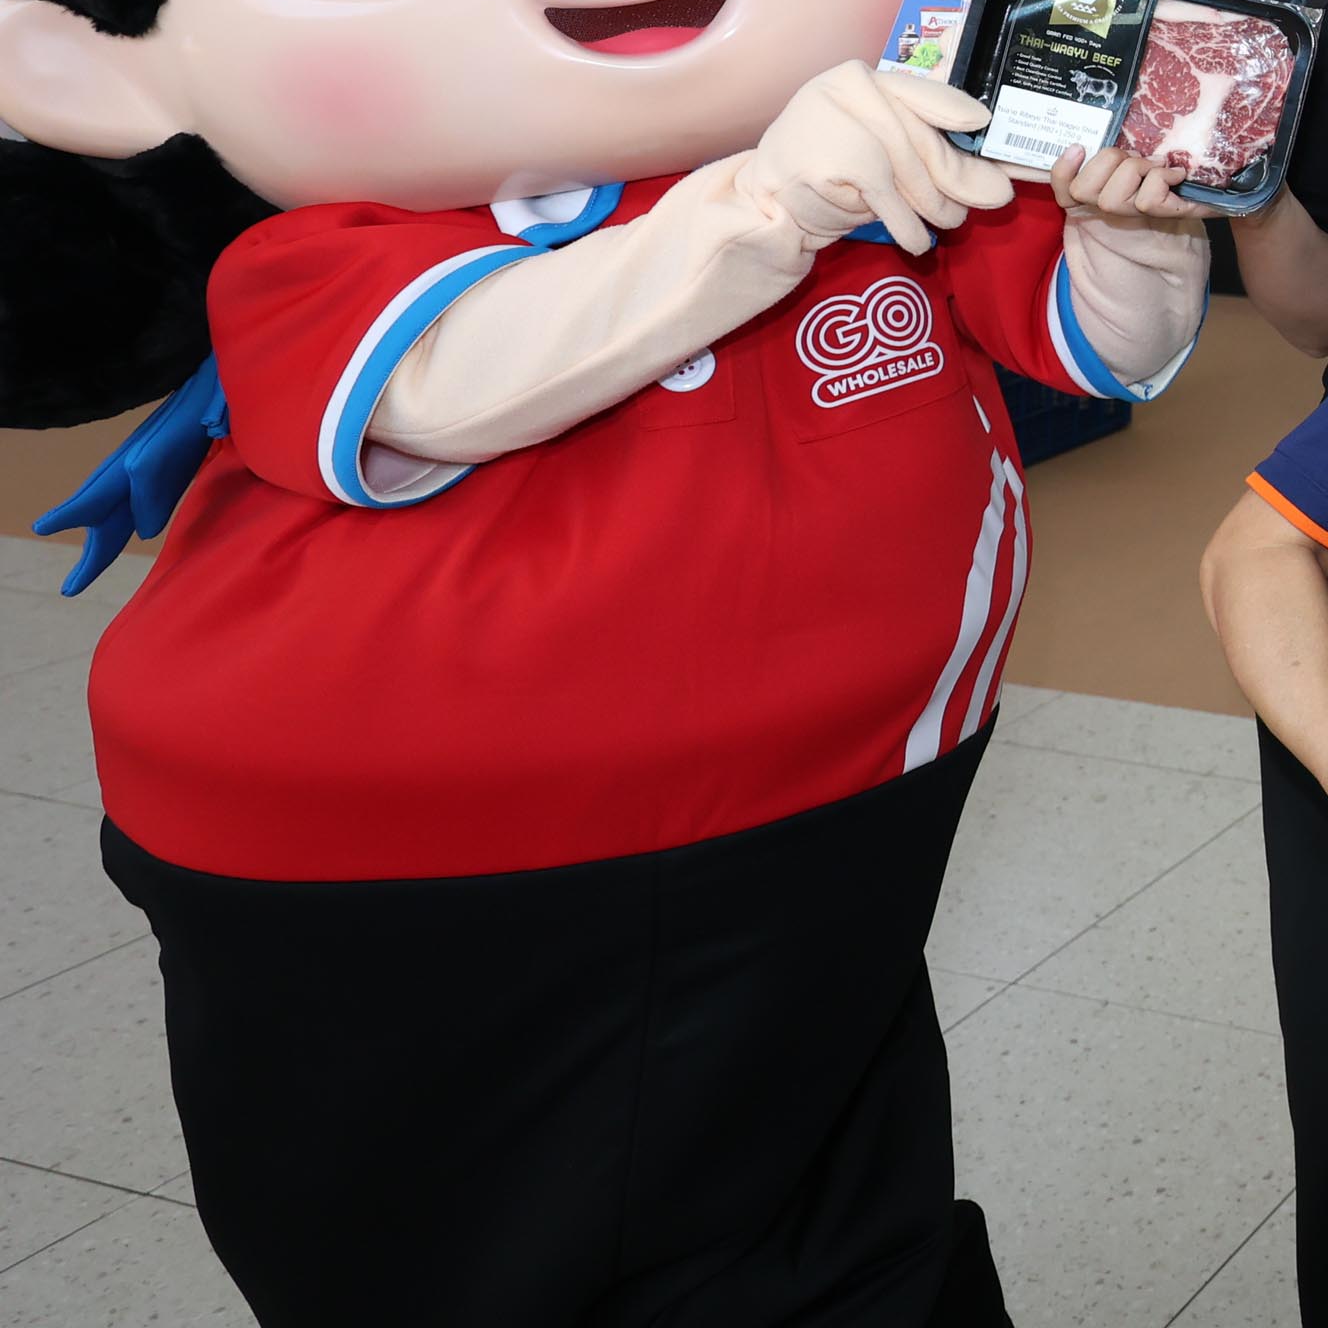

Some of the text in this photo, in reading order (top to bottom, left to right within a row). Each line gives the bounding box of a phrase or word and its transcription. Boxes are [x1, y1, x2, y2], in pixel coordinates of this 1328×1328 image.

[1092, 52, 1123, 68] BEEF
[795, 275, 933, 376] GO
[826, 352, 935, 397] WHOLESALE
